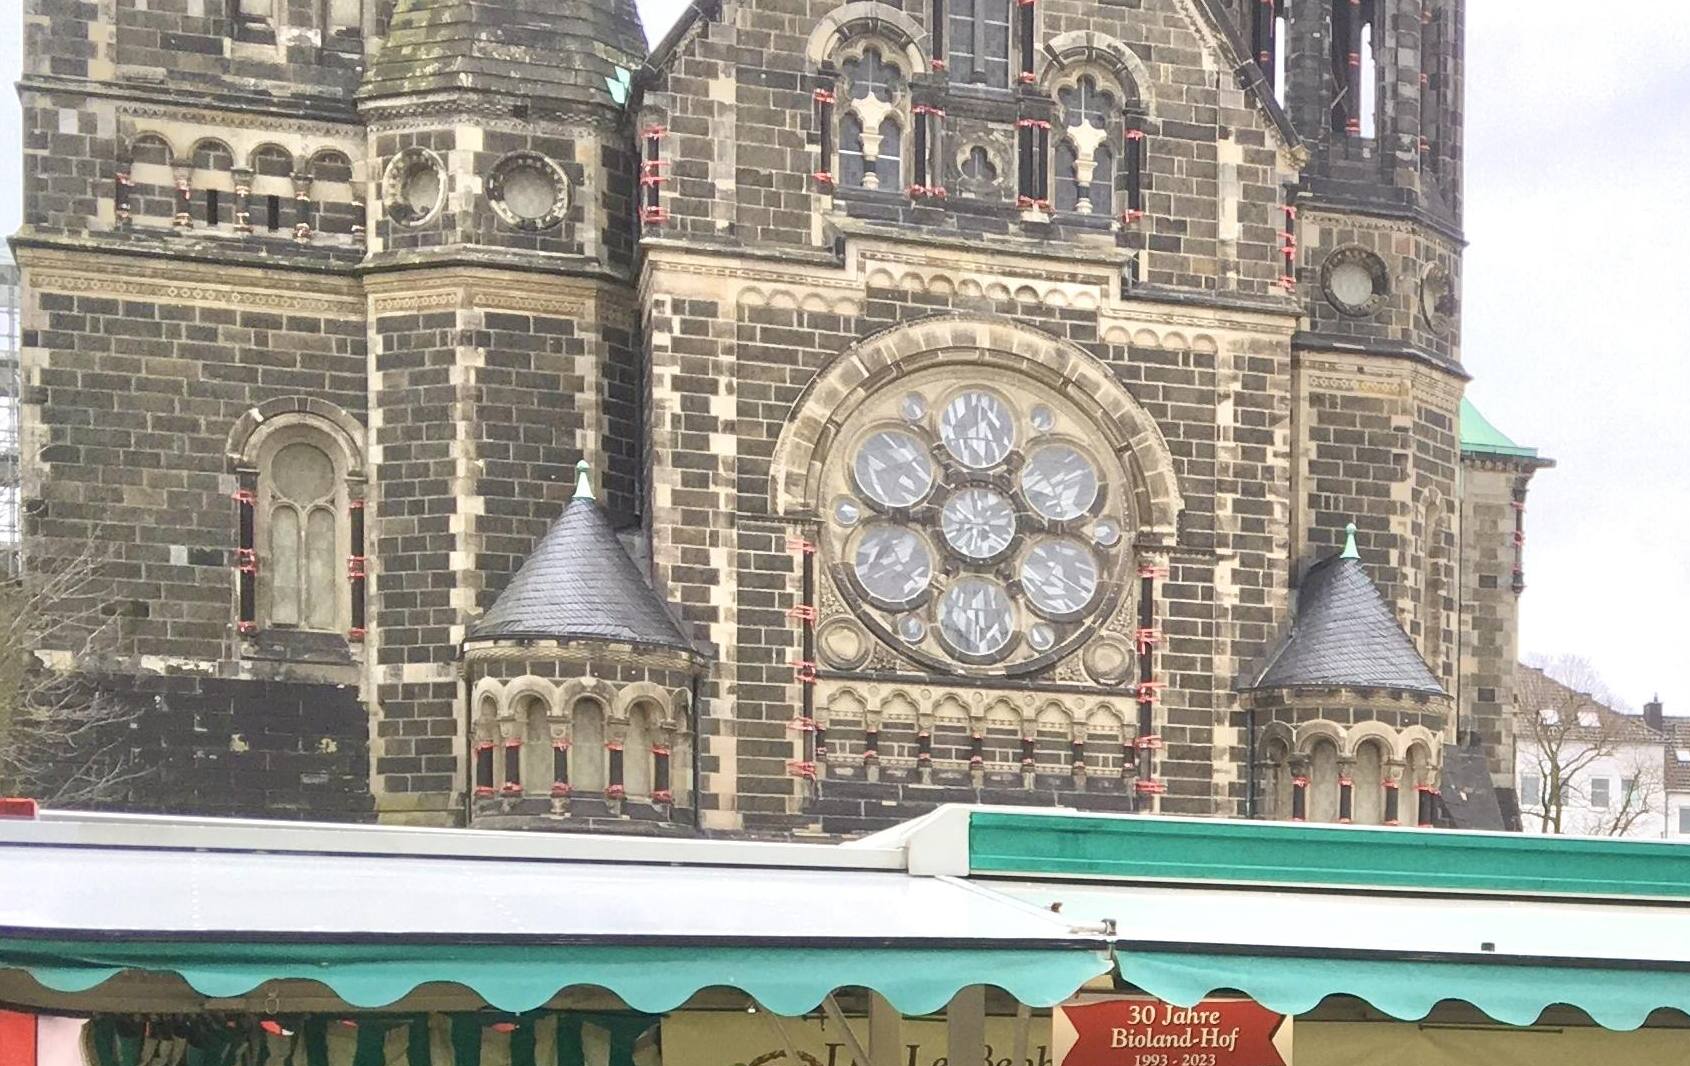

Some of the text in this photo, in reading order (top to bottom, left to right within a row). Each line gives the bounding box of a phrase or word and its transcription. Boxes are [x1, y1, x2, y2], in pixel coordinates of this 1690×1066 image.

[1127, 1005, 1221, 1025] 30 Jahre
[1111, 1027, 1239, 1051] Bioland-Hof
[1134, 1054, 1168, 1066] 1993
[1182, 1054, 1216, 1066] 2023
